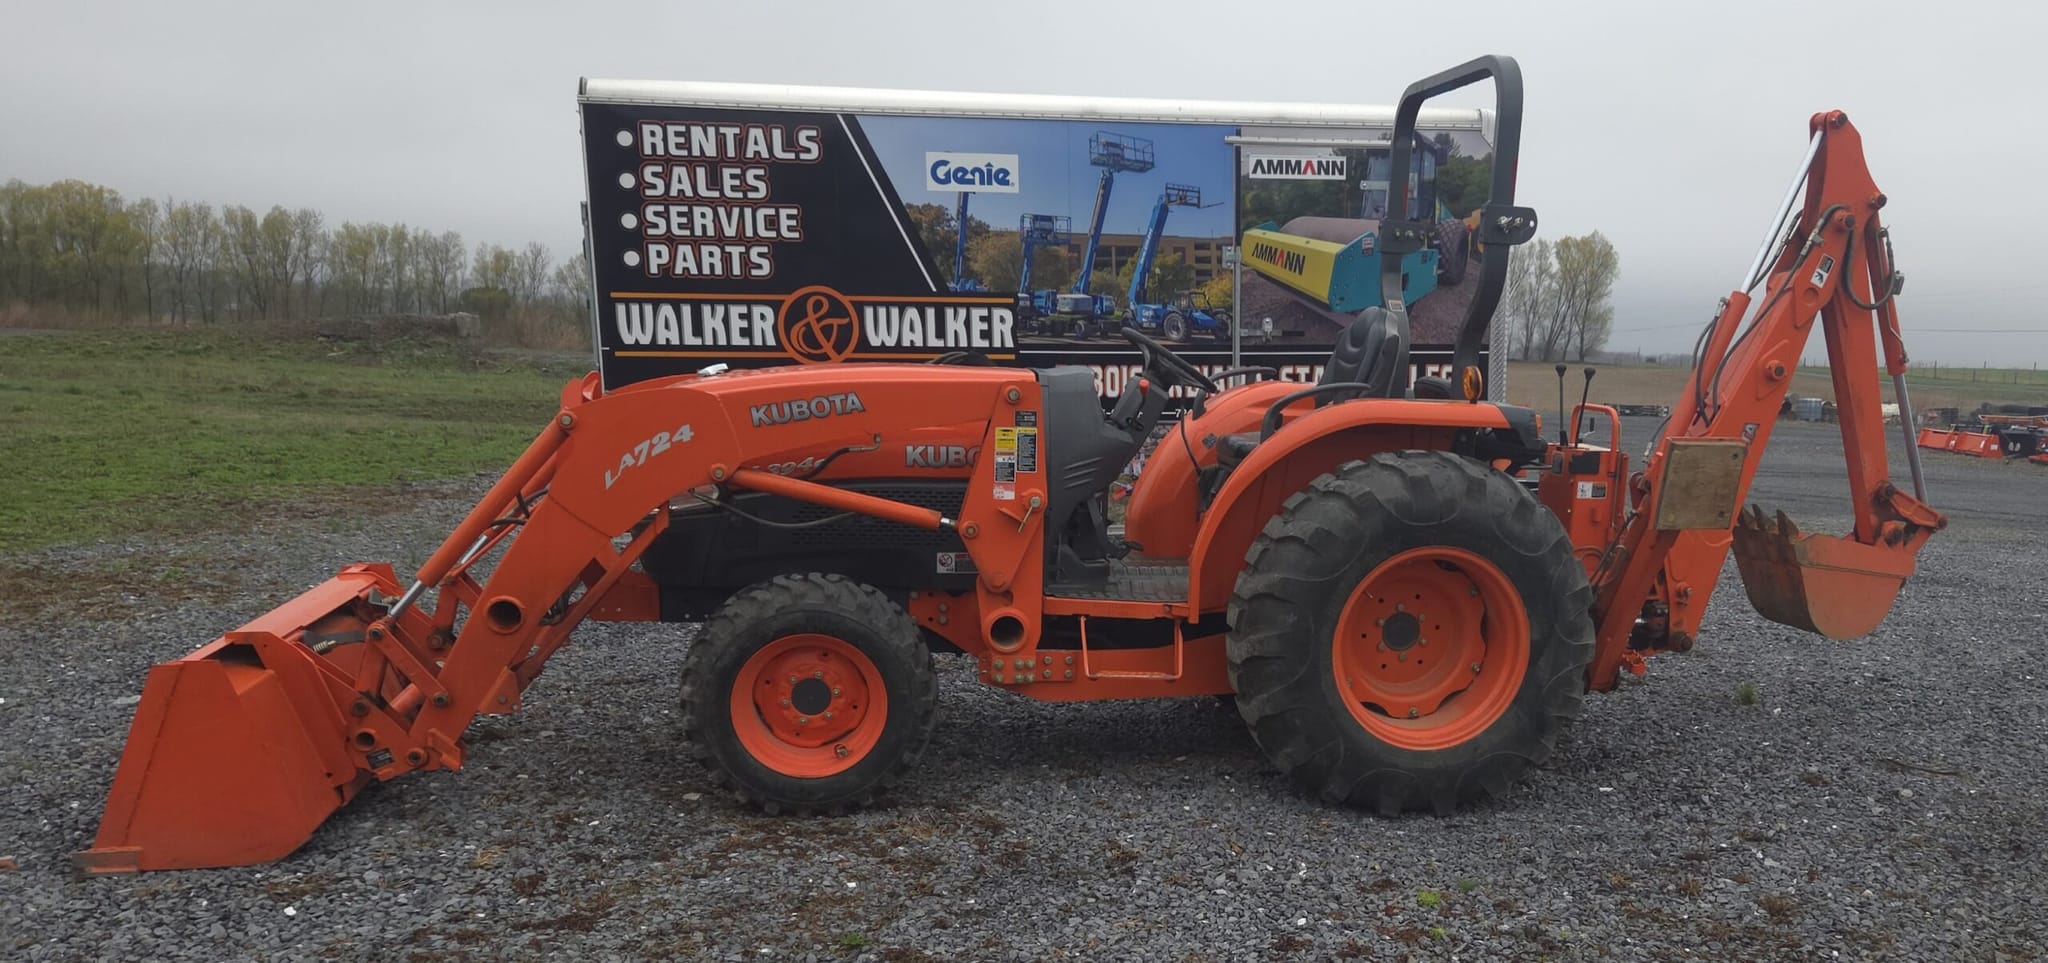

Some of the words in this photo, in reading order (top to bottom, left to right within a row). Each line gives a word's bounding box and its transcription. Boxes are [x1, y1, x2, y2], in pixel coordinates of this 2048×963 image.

[640, 123, 820, 161] RENTALS
[642, 164, 769, 199] SALES
[930, 159, 1010, 186] Genie
[1251, 158, 1345, 176] AMMANN
[644, 204, 801, 239] SERVICE
[647, 243, 772, 276] PARTS
[1251, 242, 1306, 276] AMMANN
[614, 302, 777, 346] WALKER
[790, 295, 850, 354] &
[864, 305, 1015, 349] WALKER
[750, 392, 866, 427] KUBOTA
[604, 424, 694, 490] LA724
